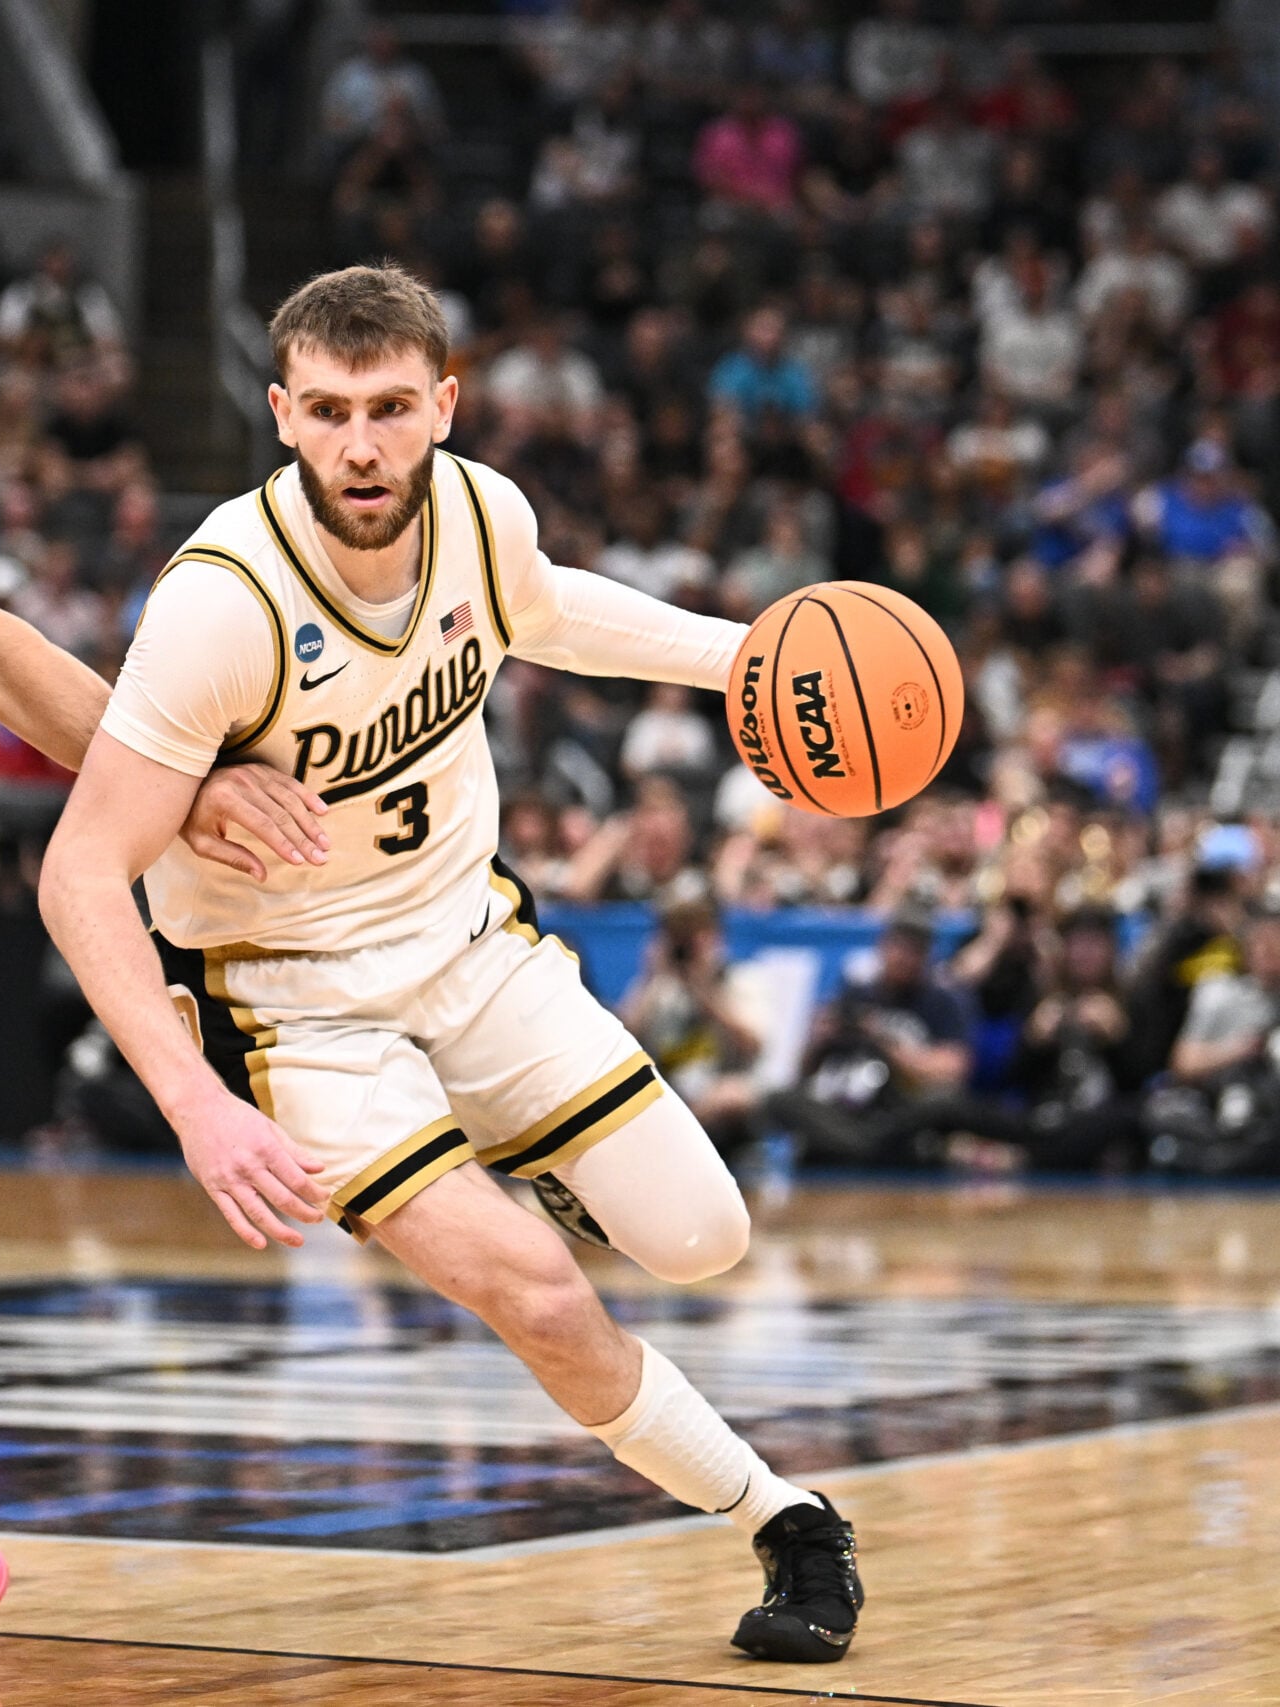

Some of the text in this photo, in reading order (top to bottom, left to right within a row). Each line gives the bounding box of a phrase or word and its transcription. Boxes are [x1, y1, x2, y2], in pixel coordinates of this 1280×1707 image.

[299, 639, 323, 655] NCAA
[291, 636, 487, 784] Purdue
[739, 655, 794, 800] Wilson
[791, 670, 846, 779] NCAA
[831, 702, 842, 733] GAME
[374, 781, 430, 856] 3
